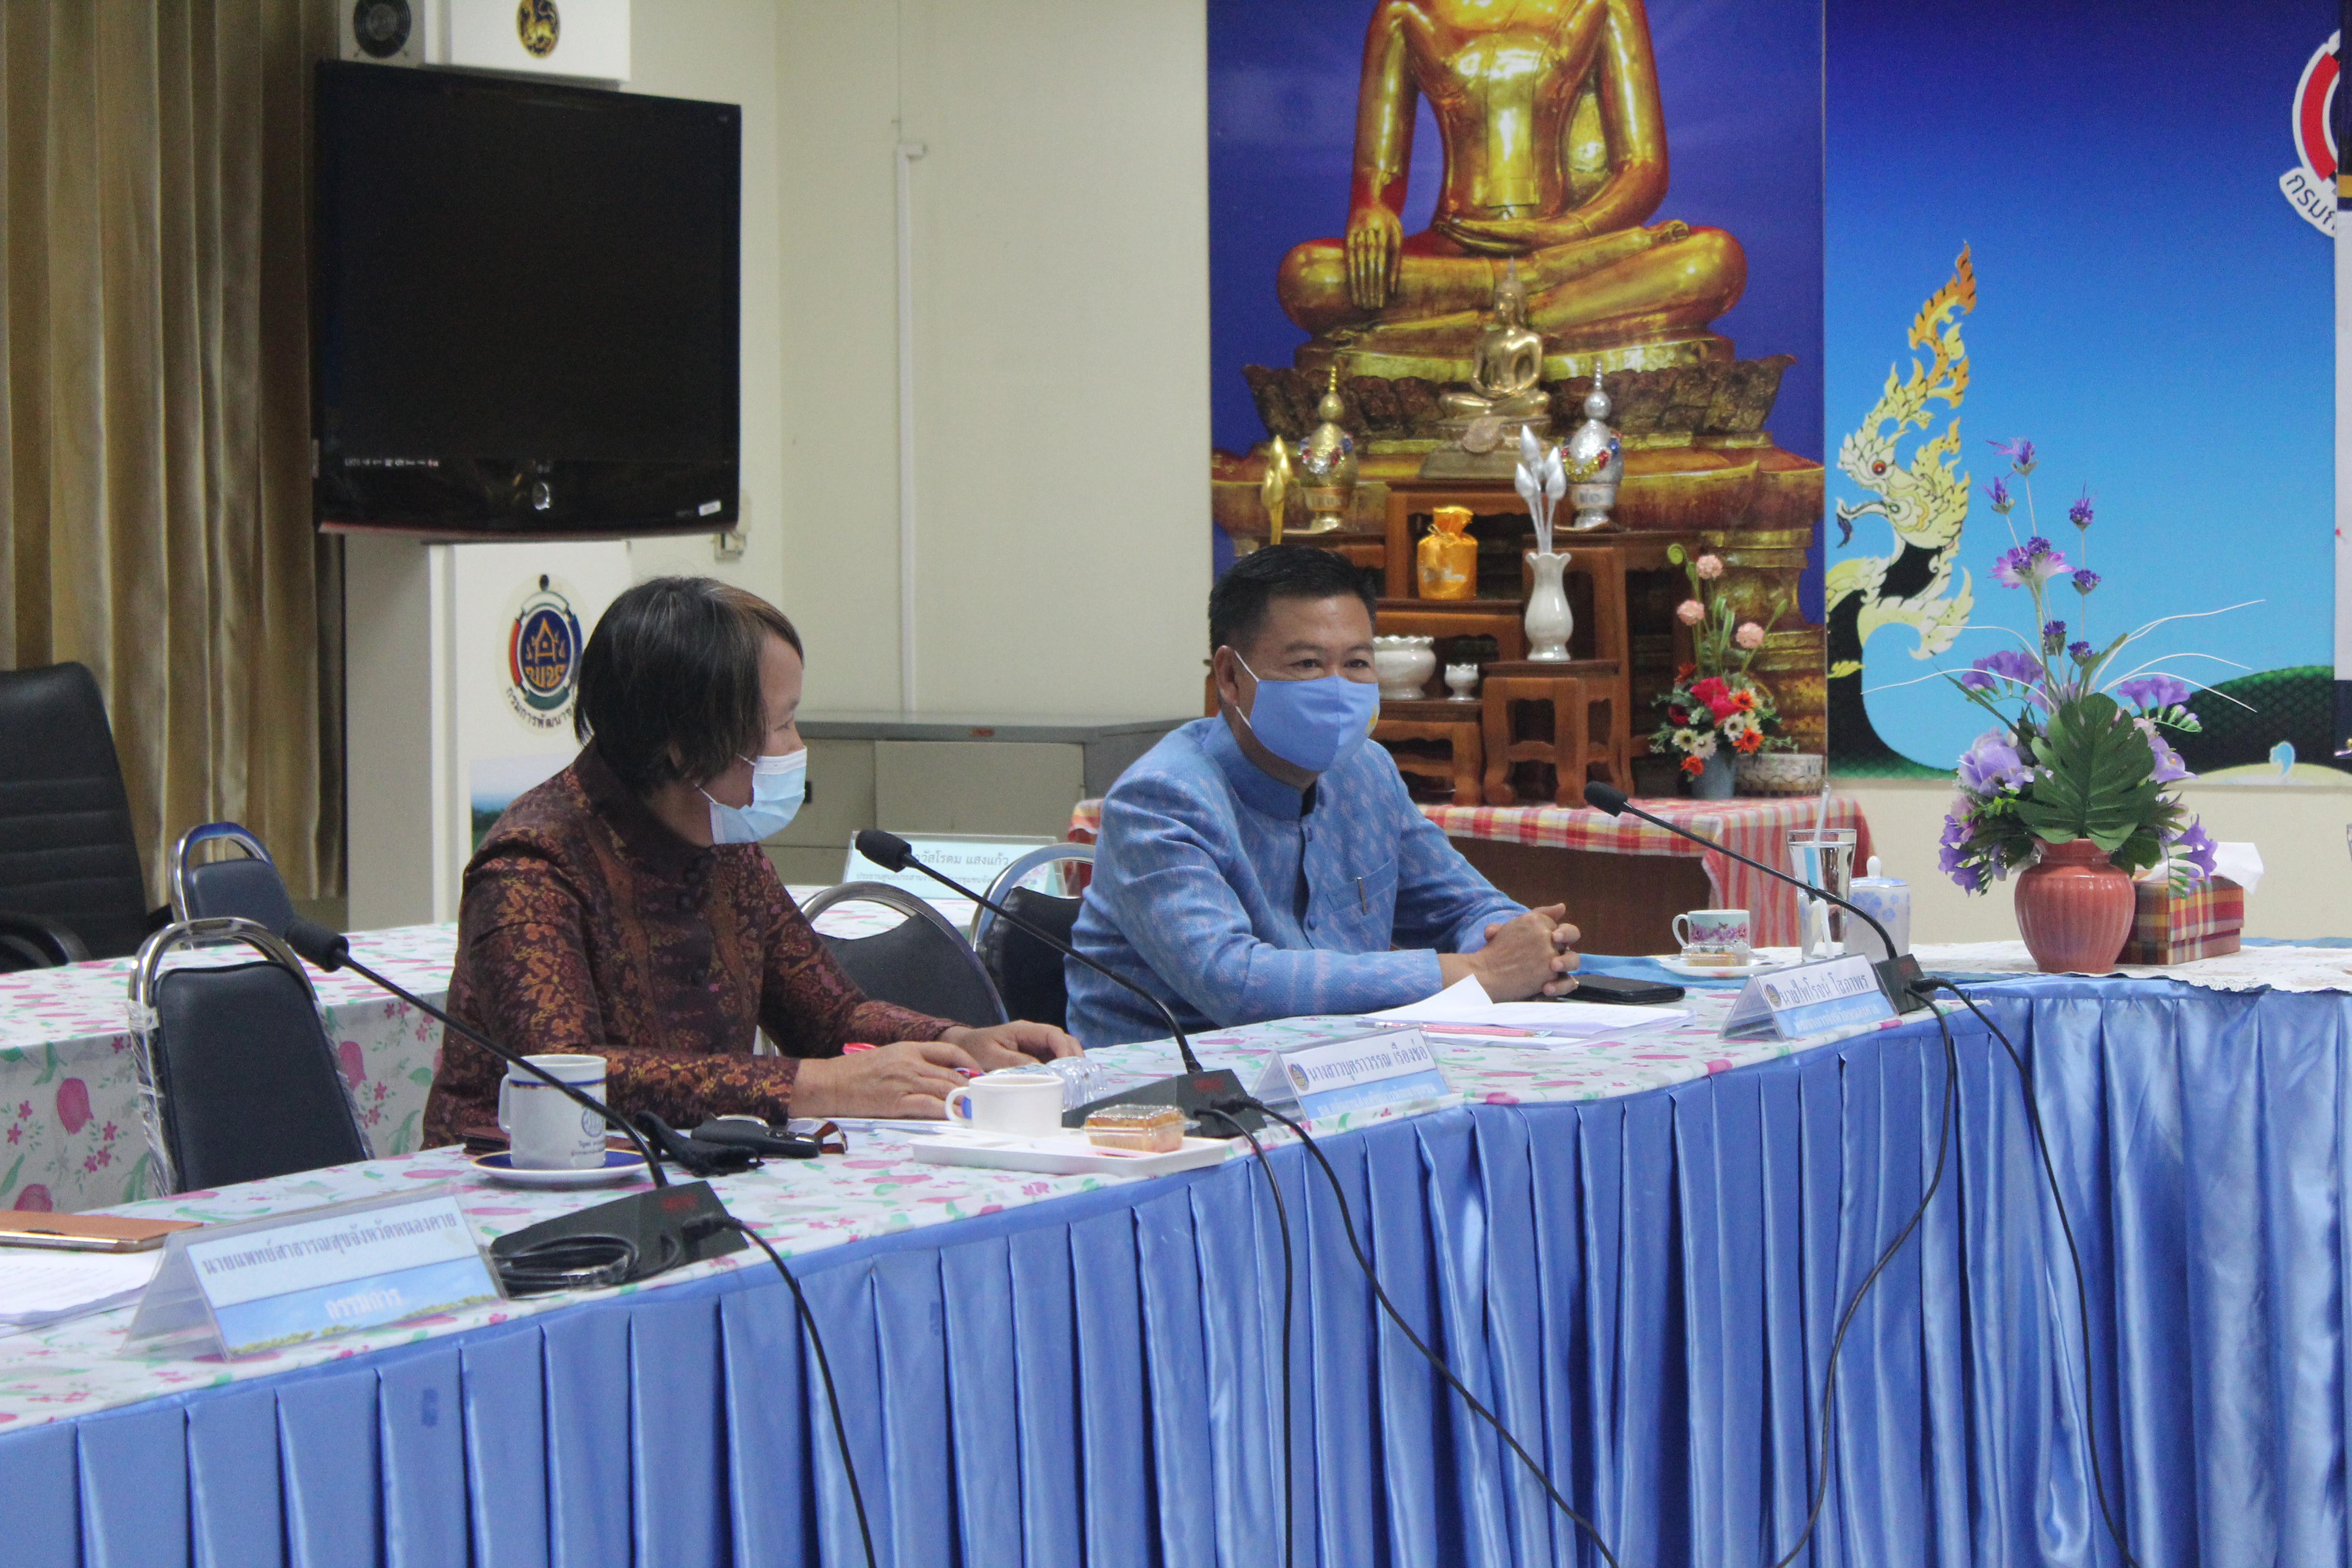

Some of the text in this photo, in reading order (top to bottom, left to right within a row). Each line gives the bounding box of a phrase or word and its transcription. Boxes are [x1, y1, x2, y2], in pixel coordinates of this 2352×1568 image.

[2286, 175, 2335, 230] กรมก
[202, 1212, 457, 1274] นายแพทย์สาธารณสุขจังหวัดหนองคาย
